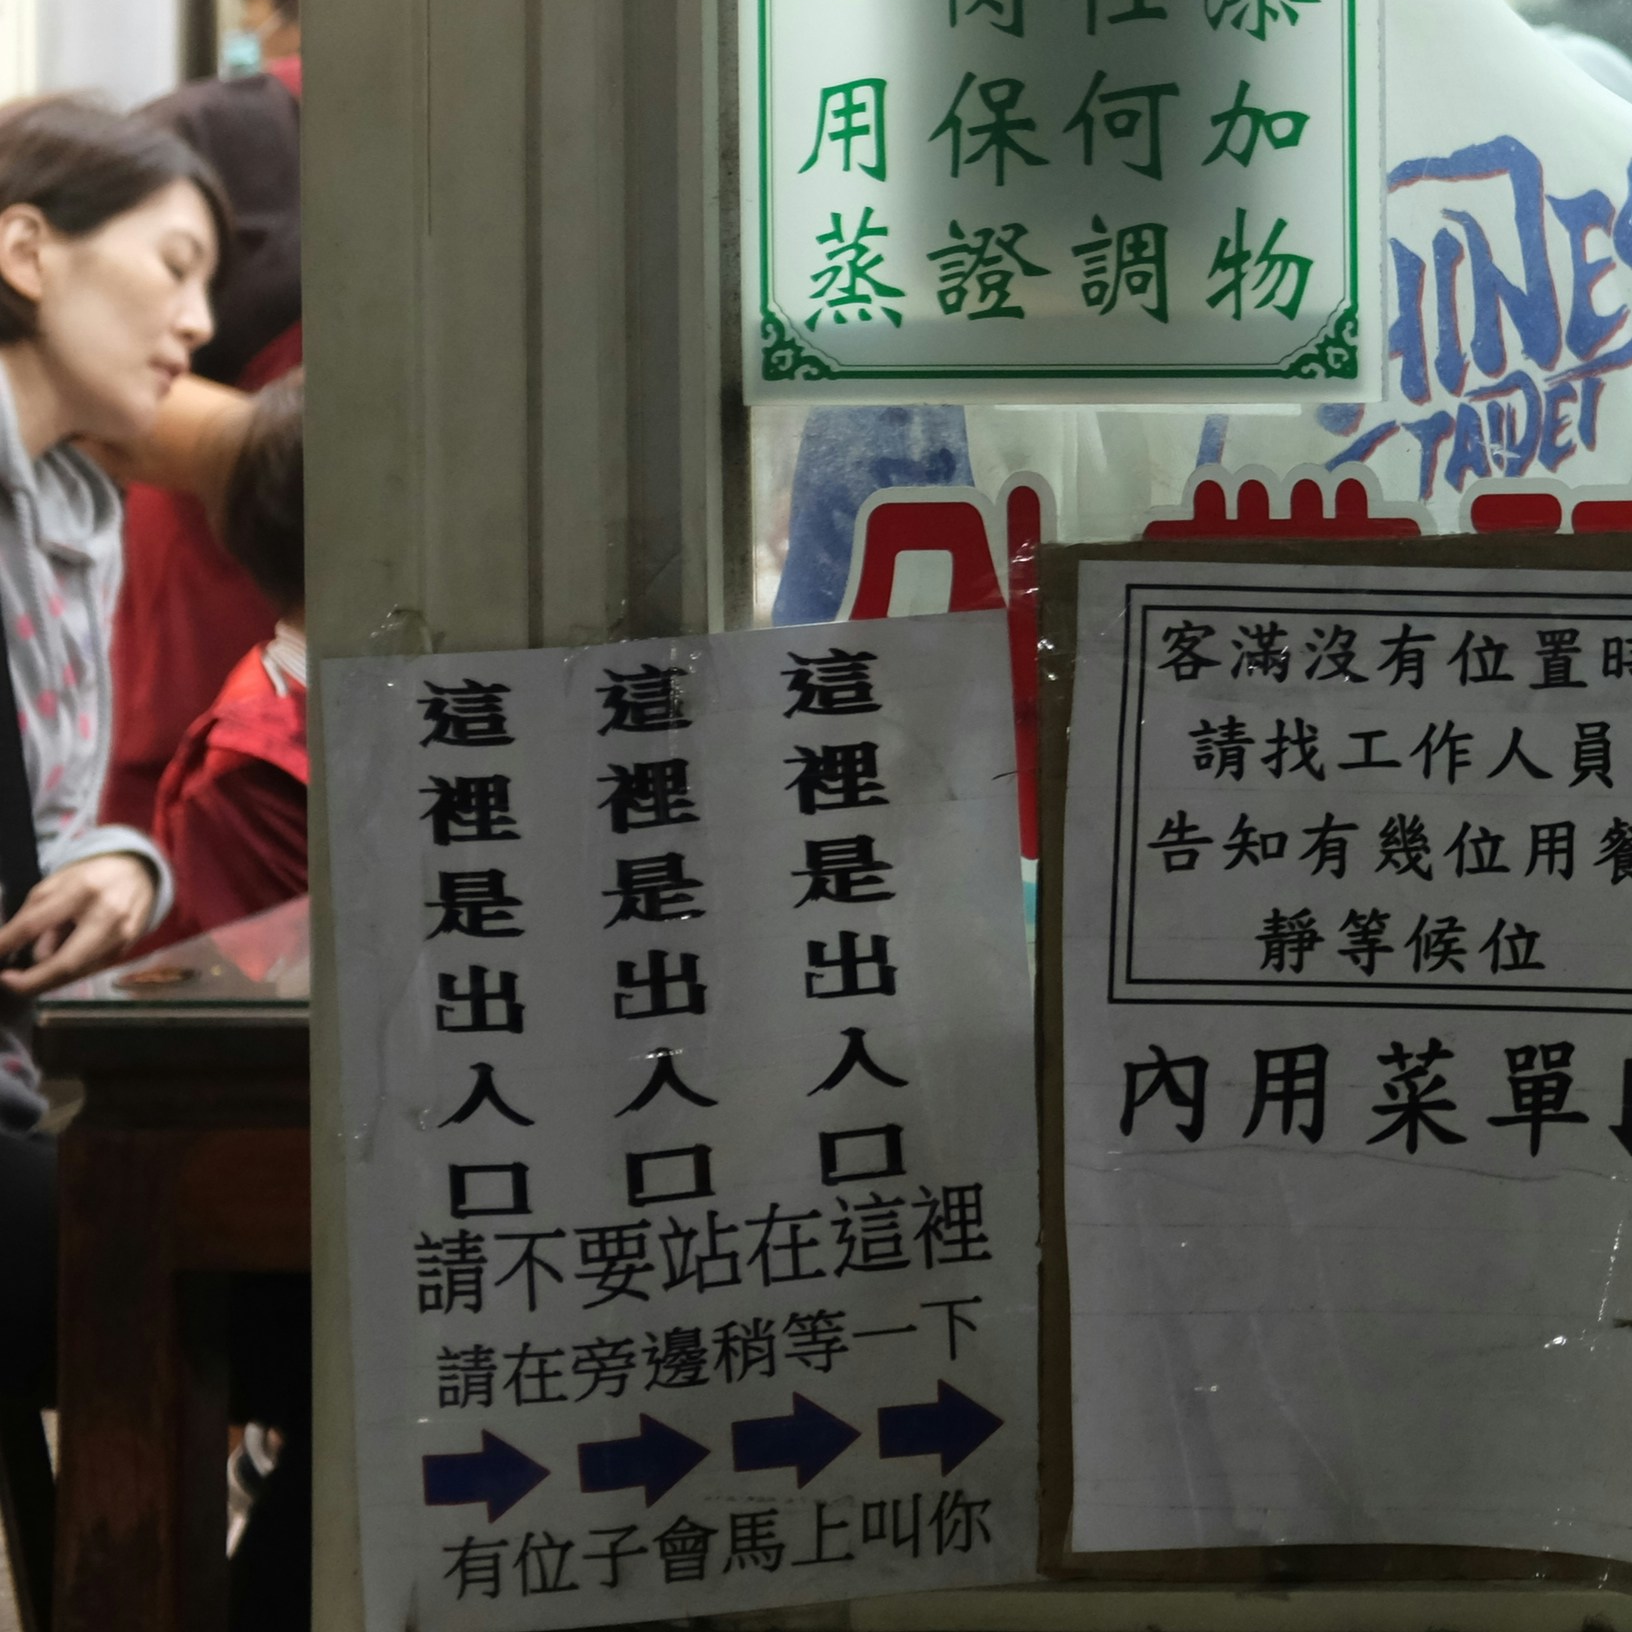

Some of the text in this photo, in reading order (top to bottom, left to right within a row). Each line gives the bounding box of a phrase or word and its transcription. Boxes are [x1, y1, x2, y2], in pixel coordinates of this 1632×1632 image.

[1188, 714, 1615, 789] 請找工作人員
[415, 677, 536, 1220] 這裡是出入口
[595, 662, 719, 1208] 這裡是出入口
[781, 646, 909, 1187] 這裡是出入口
[1254, 906, 1546, 977] 靜等候位
[1119, 1037, 1591, 1159] 內用菜單
[413, 1182, 993, 1316] 請不要站在這裡
[437, 1295, 983, 1409] 請在旁邊稍等一下
[443, 1488, 992, 1601] 有位子會馬上叫你
